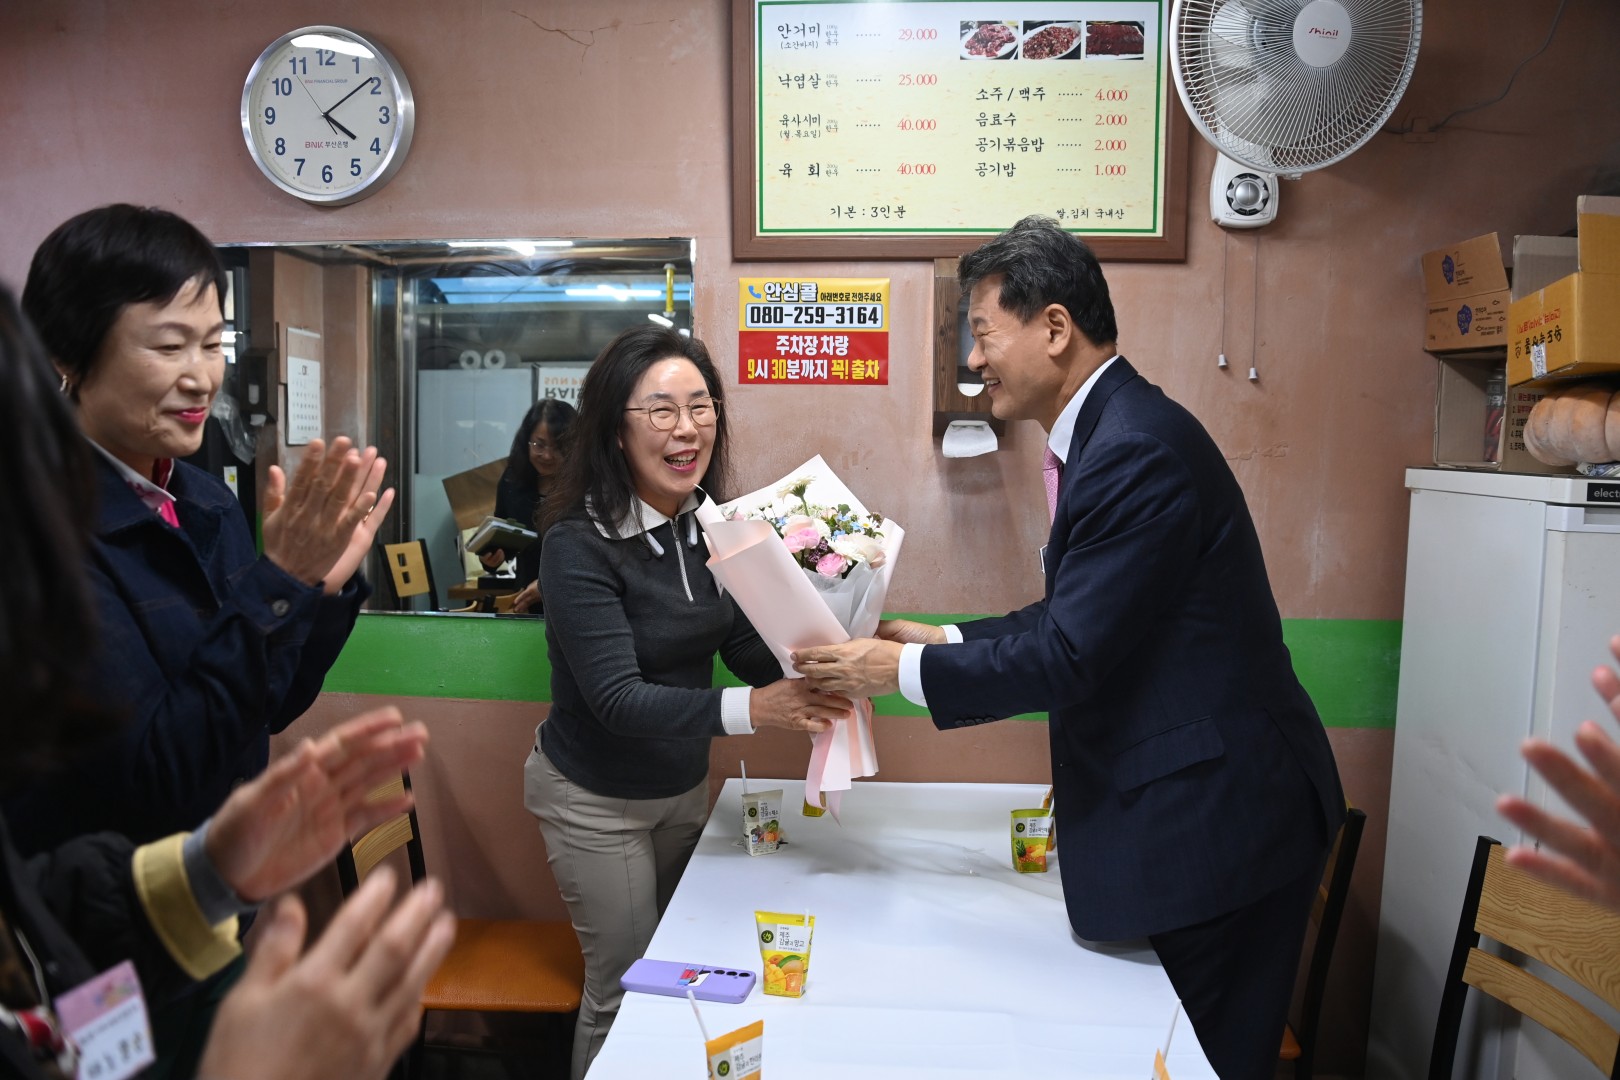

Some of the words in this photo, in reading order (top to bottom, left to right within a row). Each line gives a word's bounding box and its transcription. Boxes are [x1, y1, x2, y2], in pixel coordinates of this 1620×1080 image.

[778, 22, 821, 39] 안거미
[898, 28, 938, 41] 29.000
[289, 56, 307, 75] 11
[316, 49, 336, 66] 12
[351, 56, 360, 74] 1
[272, 77, 292, 96] 10
[370, 76, 382, 95] 2
[778, 72, 822, 90] 낙엽살
[898, 73, 938, 86] 25.000
[975, 87, 1003, 102] 소주
[1019, 86, 1046, 102] 맥주
[1095, 88, 1128, 101] 4.000
[264, 106, 276, 125] 9
[378, 106, 390, 124] 3
[779, 113, 821, 128] 육사시미
[897, 118, 937, 131] 40.000
[975, 112, 1017, 127] 음료수
[1095, 114, 1128, 126] 2.000
[274, 137, 286, 156] 8
[305, 141, 324, 149] BNK
[325, 140, 349, 149] 부산은행
[369, 137, 381, 155] 4
[975, 137, 1045, 152] 공기볶음밥
[1095, 139, 1127, 151] 2.000
[294, 158, 306, 176] 7
[321, 165, 333, 183] 6
[350, 158, 361, 177] 5
[897, 162, 937, 175] 40.000
[975, 162, 1017, 178] 공기밥
[1095, 164, 1126, 176] 1.000
[830, 205, 857, 219] 기본
[870, 205, 907, 219] 3인분
[1095, 208, 1125, 220] 국내산
[764, 282, 818, 302] 안심콜
[820, 292, 851, 303] 아래번호로
[852, 292, 882, 303] 전화주세요
[750, 306, 879, 325] 080-259-3164
[775, 335, 819, 356] 주차장
[820, 335, 849, 356] 차량
[747, 358, 769, 380] 9시
[771, 358, 828, 380] 30분까지
[831, 358, 849, 380] 꼭!
[851, 359, 880, 380] 출차
